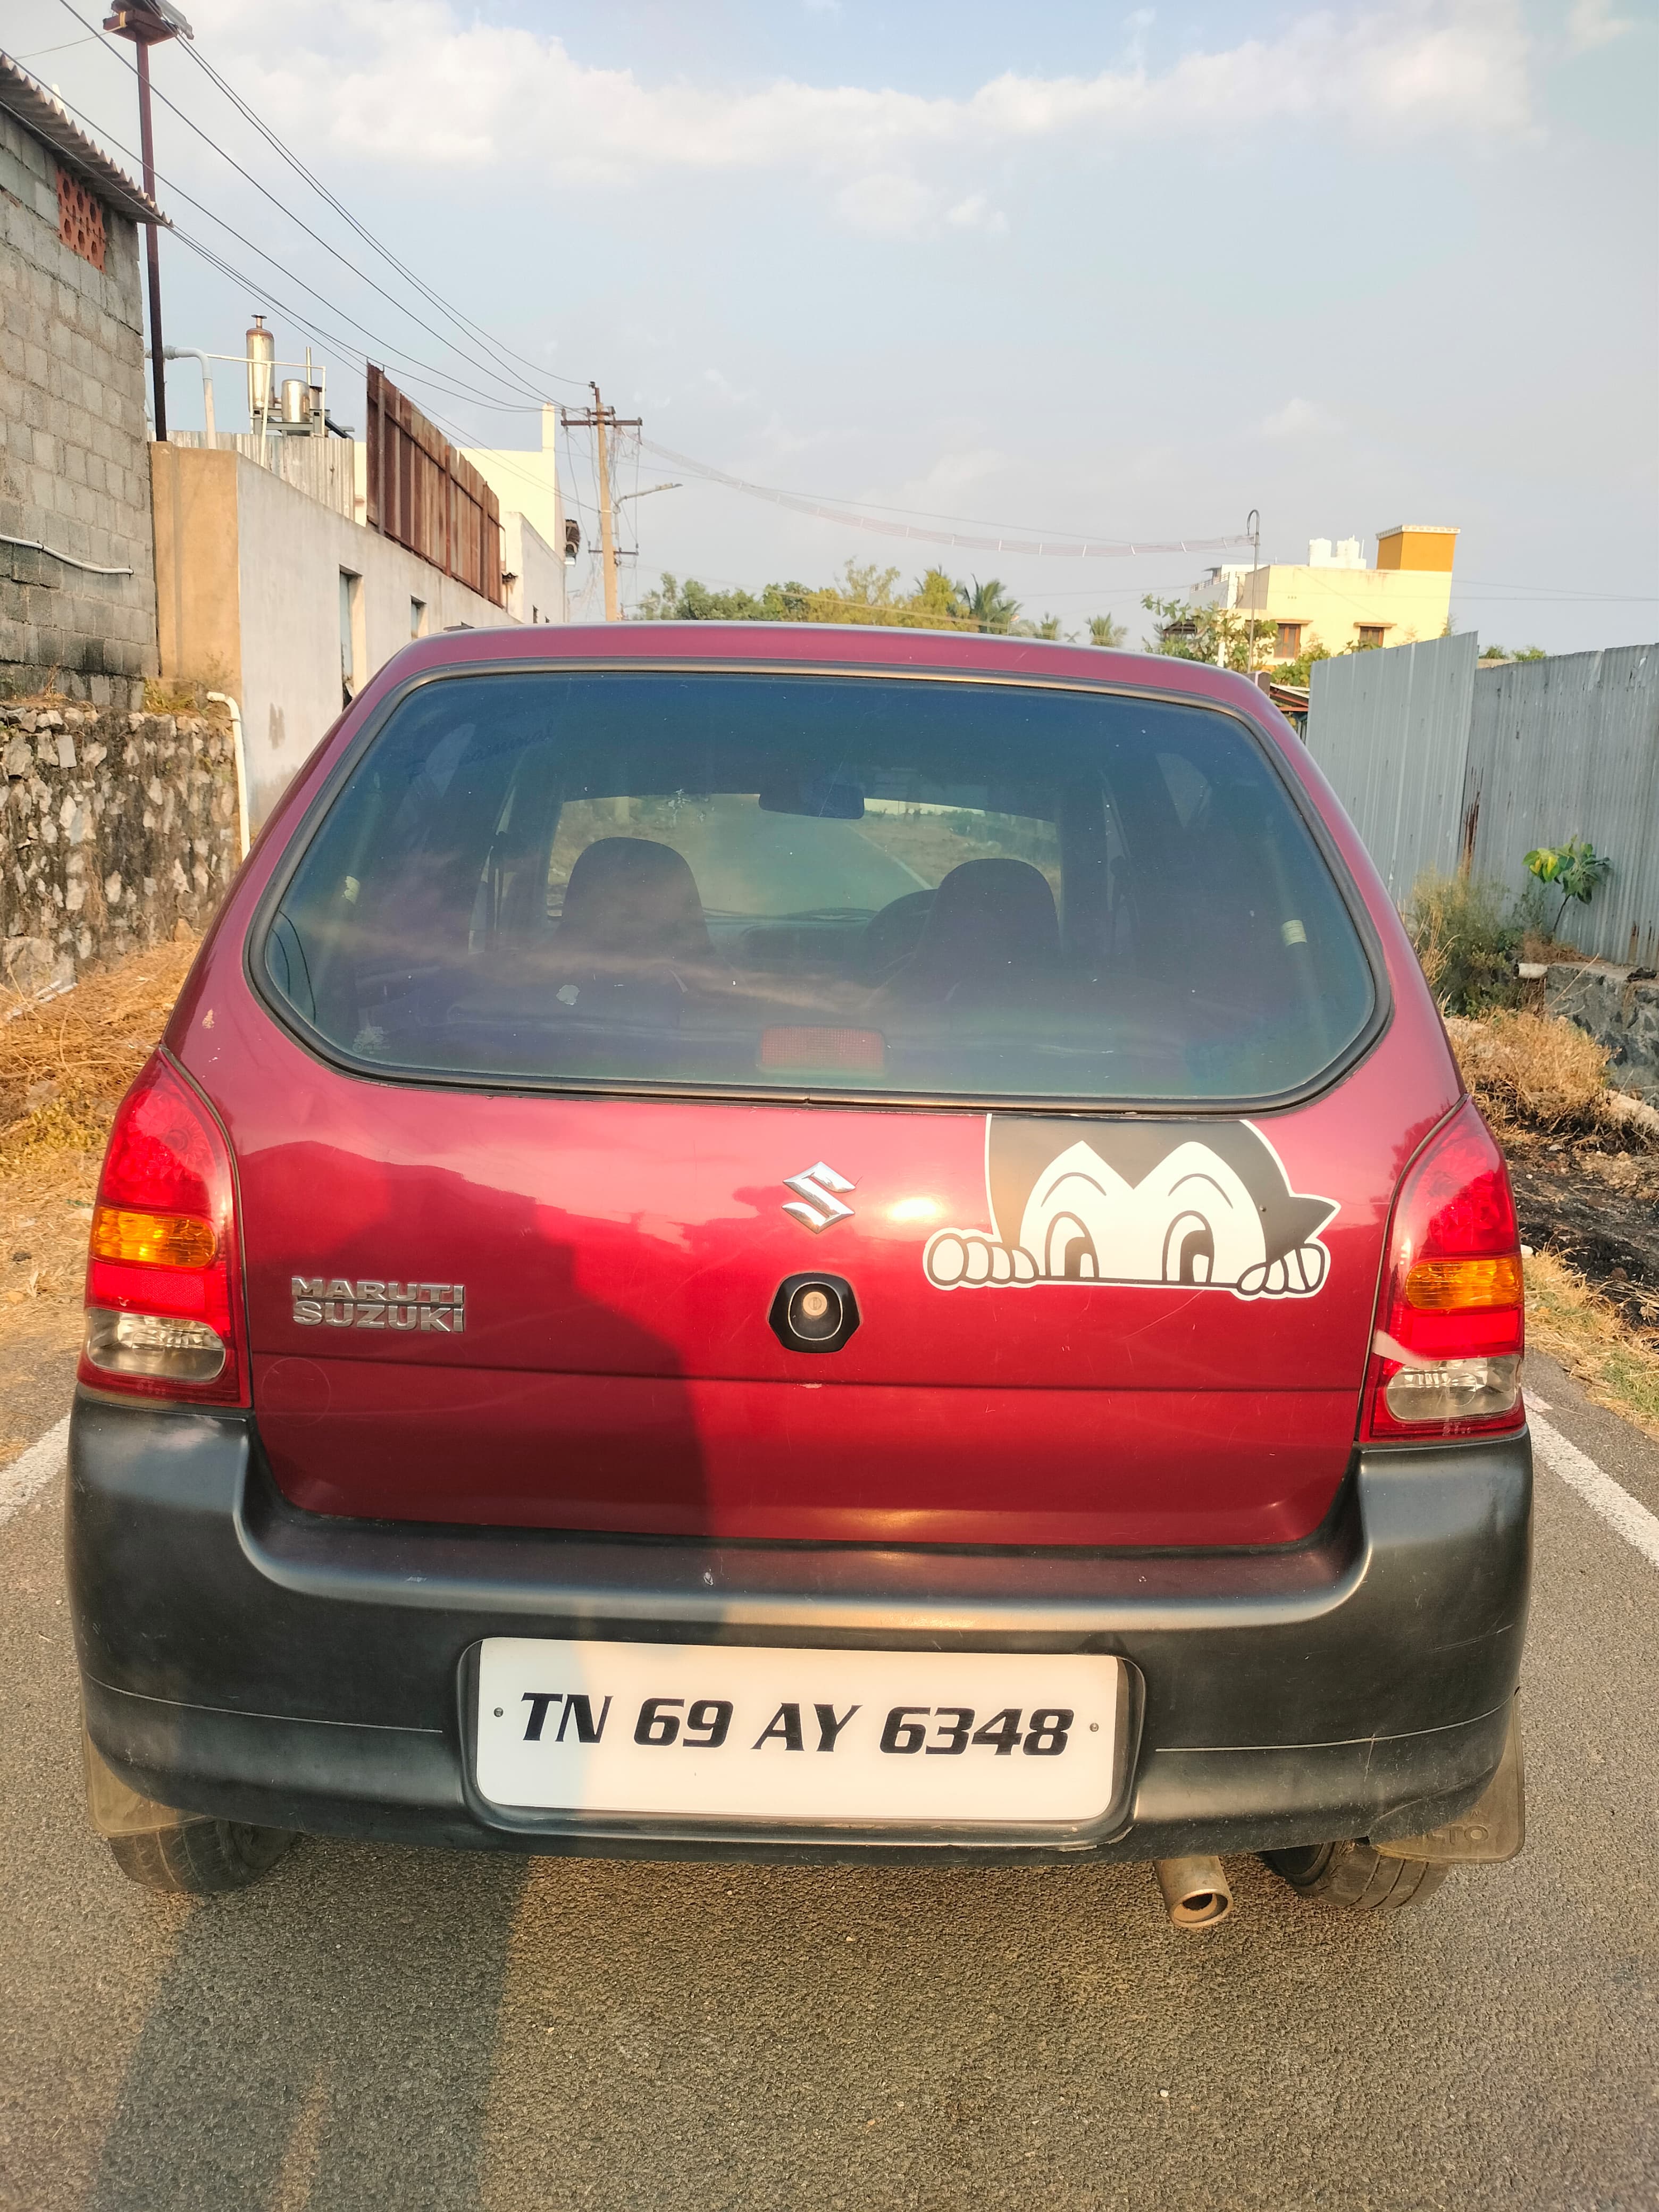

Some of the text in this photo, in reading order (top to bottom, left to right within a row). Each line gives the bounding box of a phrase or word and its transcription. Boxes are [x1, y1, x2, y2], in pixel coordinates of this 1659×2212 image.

[291, 1277, 465, 1304] MARUTI
[292, 1300, 464, 1333] SUZUKI
[521, 1692, 1074, 1756] TN 69 AY 6348
